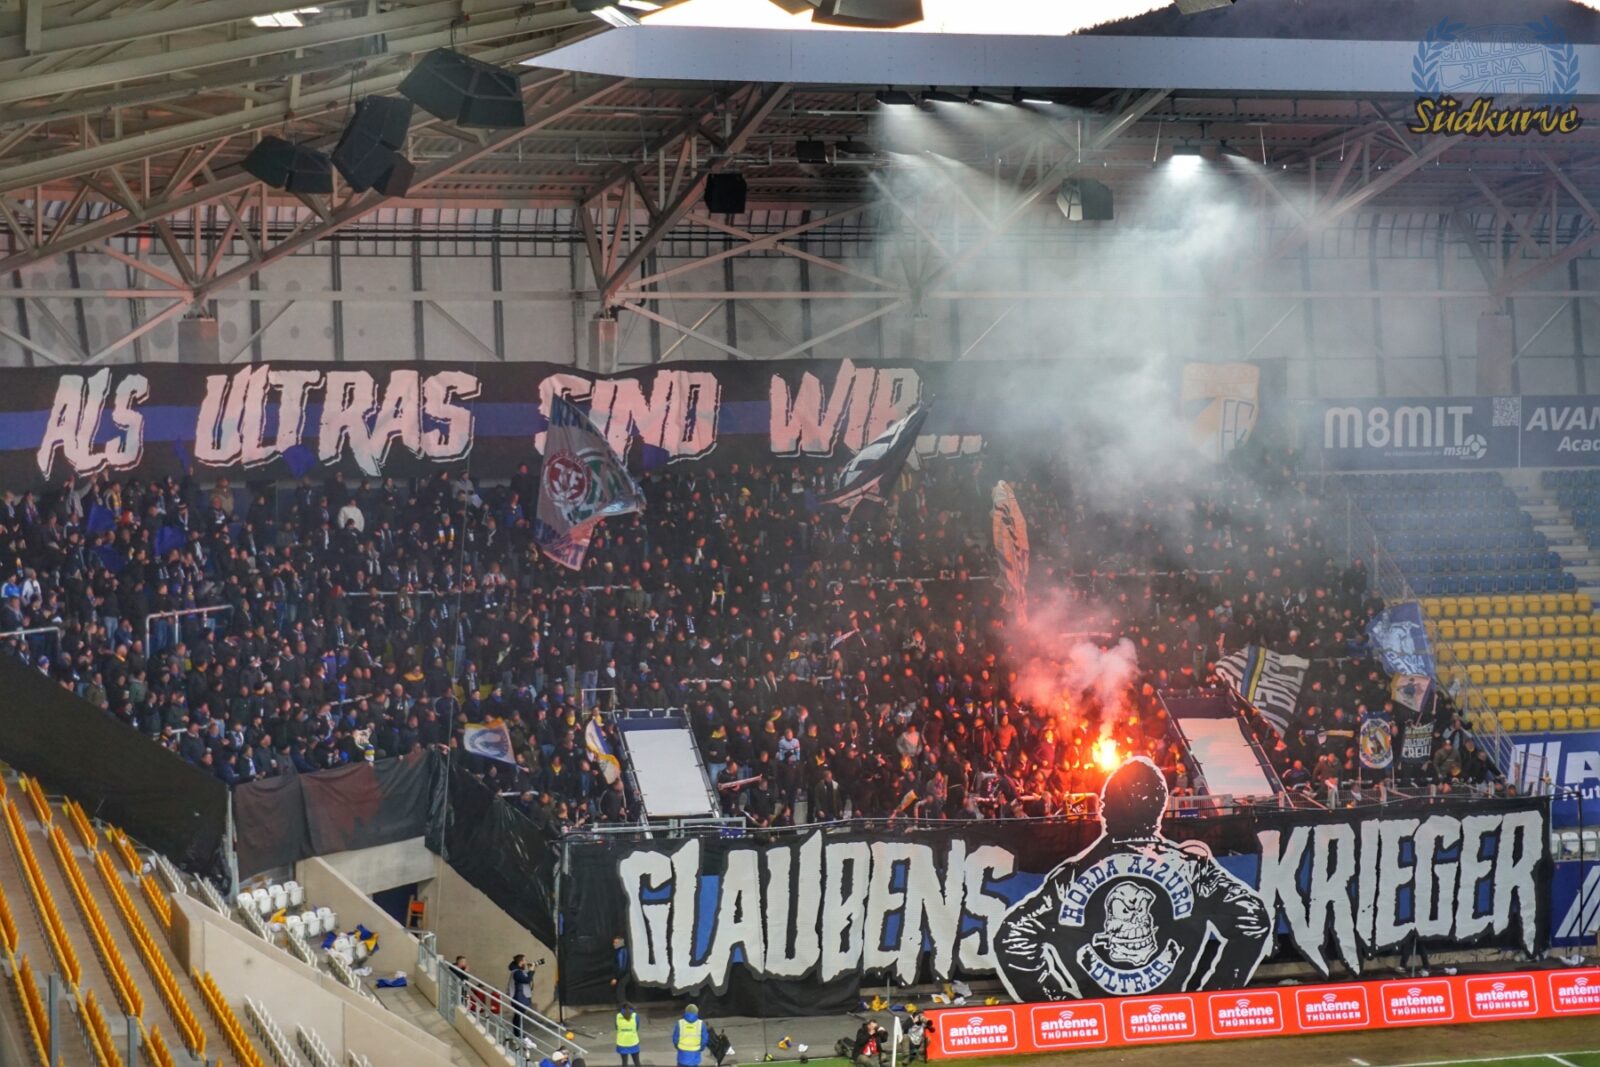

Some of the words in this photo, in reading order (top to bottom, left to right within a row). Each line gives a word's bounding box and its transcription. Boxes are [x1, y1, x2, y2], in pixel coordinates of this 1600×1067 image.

[37, 366, 149, 481] ALS
[195, 364, 482, 477] ULTRAS
[1060, 860, 1119, 924] HORDA
[1127, 856, 1192, 917] AZZURO
[619, 830, 1015, 990] GLAUBENS
[1256, 810, 1544, 977] KRIEGER
[1091, 959, 1172, 993] ULTRAS
[1390, 994, 1444, 1007] antenne
[1475, 989, 1528, 1002] antenne
[1305, 1000, 1360, 1013] antenne
[1391, 1004, 1446, 1016] THÜRINGEN
[1476, 999, 1530, 1010] THÜRINGEN
[1130, 1011, 1186, 1025] antenne
[1218, 1006, 1273, 1020] antenne
[1306, 1010, 1361, 1021] THÜRINGEN
[1040, 1017, 1098, 1031] antenne
[1131, 1022, 1188, 1033] THÜRINGEN
[1219, 1016, 1275, 1028] THÜRINGEN
[949, 1023, 1007, 1037] antenne
[1041, 1028, 1099, 1040] THÜRINGEN
[950, 1034, 1009, 1046] THÜRINGEN
